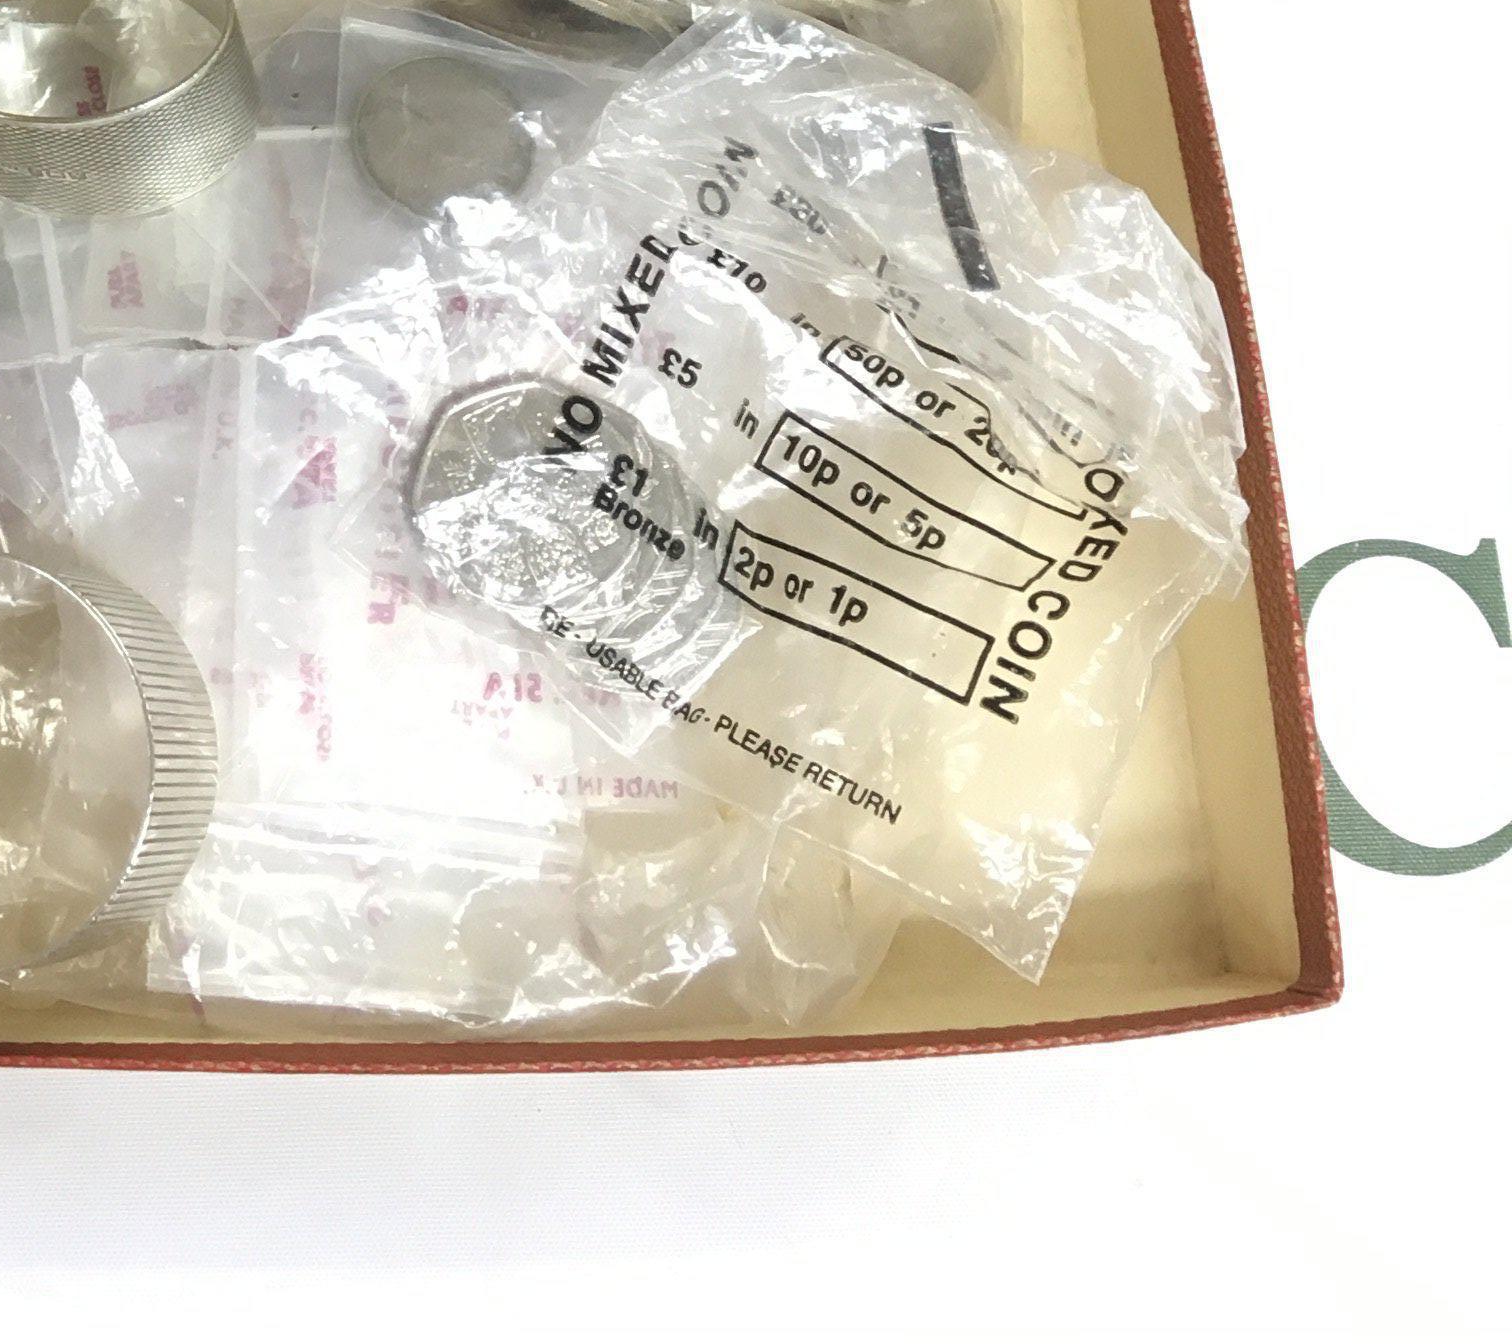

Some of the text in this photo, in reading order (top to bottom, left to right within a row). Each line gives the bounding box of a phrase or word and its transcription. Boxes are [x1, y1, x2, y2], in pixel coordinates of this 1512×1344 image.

[579, 233, 680, 388] MIXED
[843, 342, 905, 389] 50p
[914, 389, 957, 418] or
[608, 453, 649, 498] £1
[657, 346, 947, 553] £5 in 10p or 5p
[592, 482, 871, 627] Bronze in 2p or 1p
[979, 587, 1072, 726] COIN
[713, 714, 804, 774] PLEASE
[802, 761, 903, 826] RETURN
